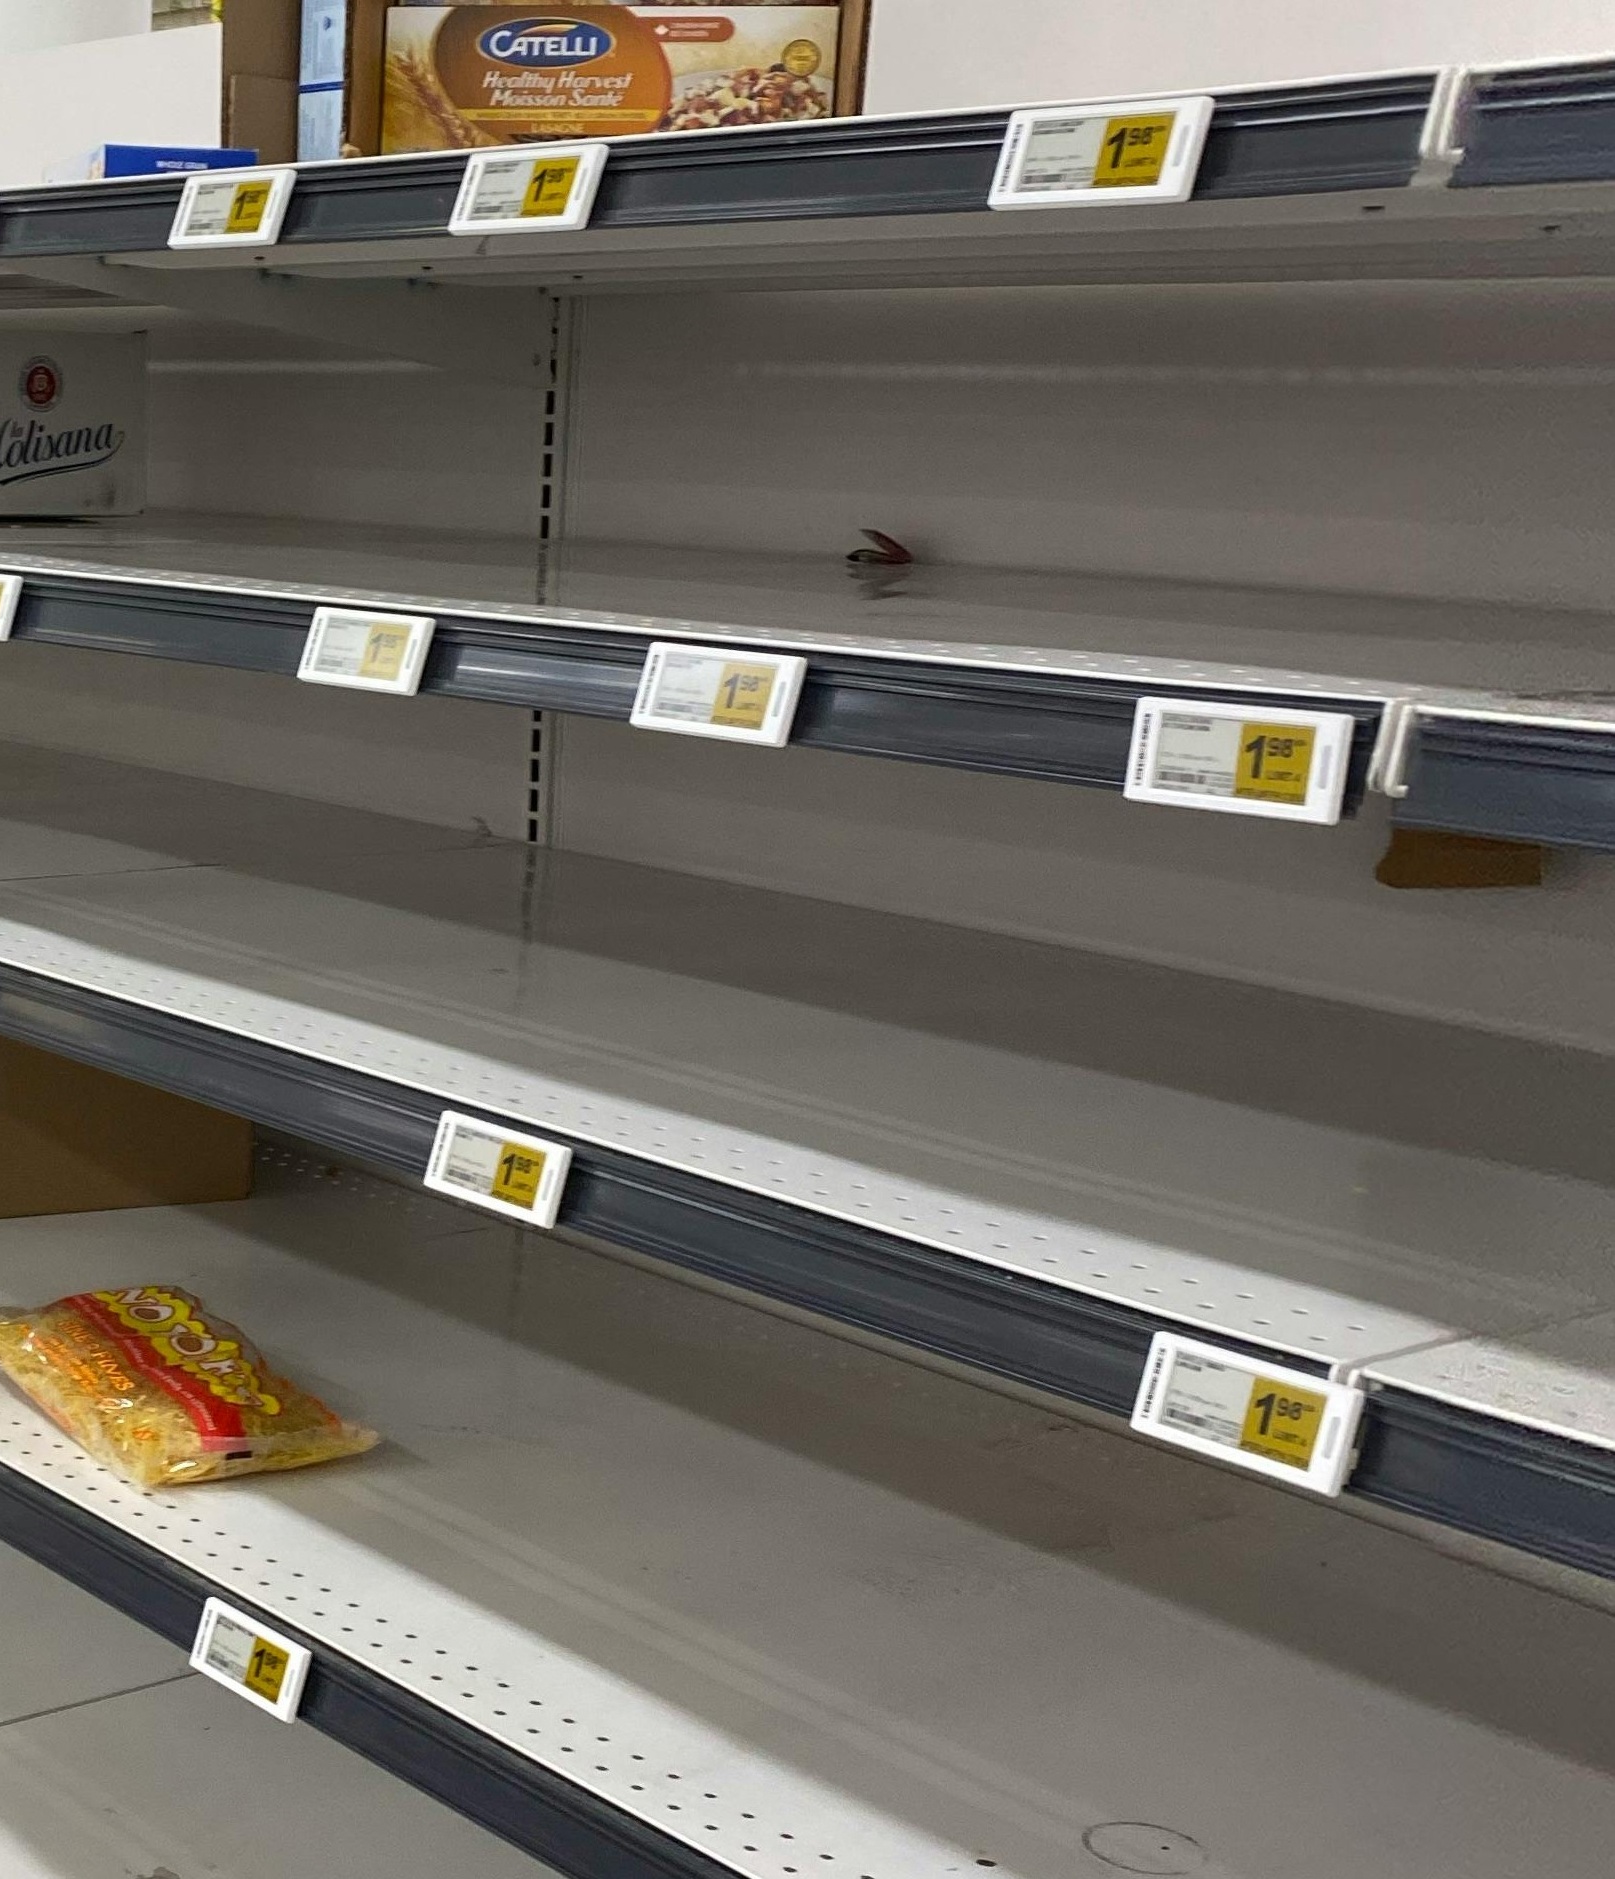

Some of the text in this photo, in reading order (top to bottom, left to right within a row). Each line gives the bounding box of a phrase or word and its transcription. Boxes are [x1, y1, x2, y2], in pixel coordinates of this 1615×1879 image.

[489, 30, 597, 58] CATELLI
[482, 70, 633, 93] Healthy Harvest
[489, 89, 567, 106] Moisson
